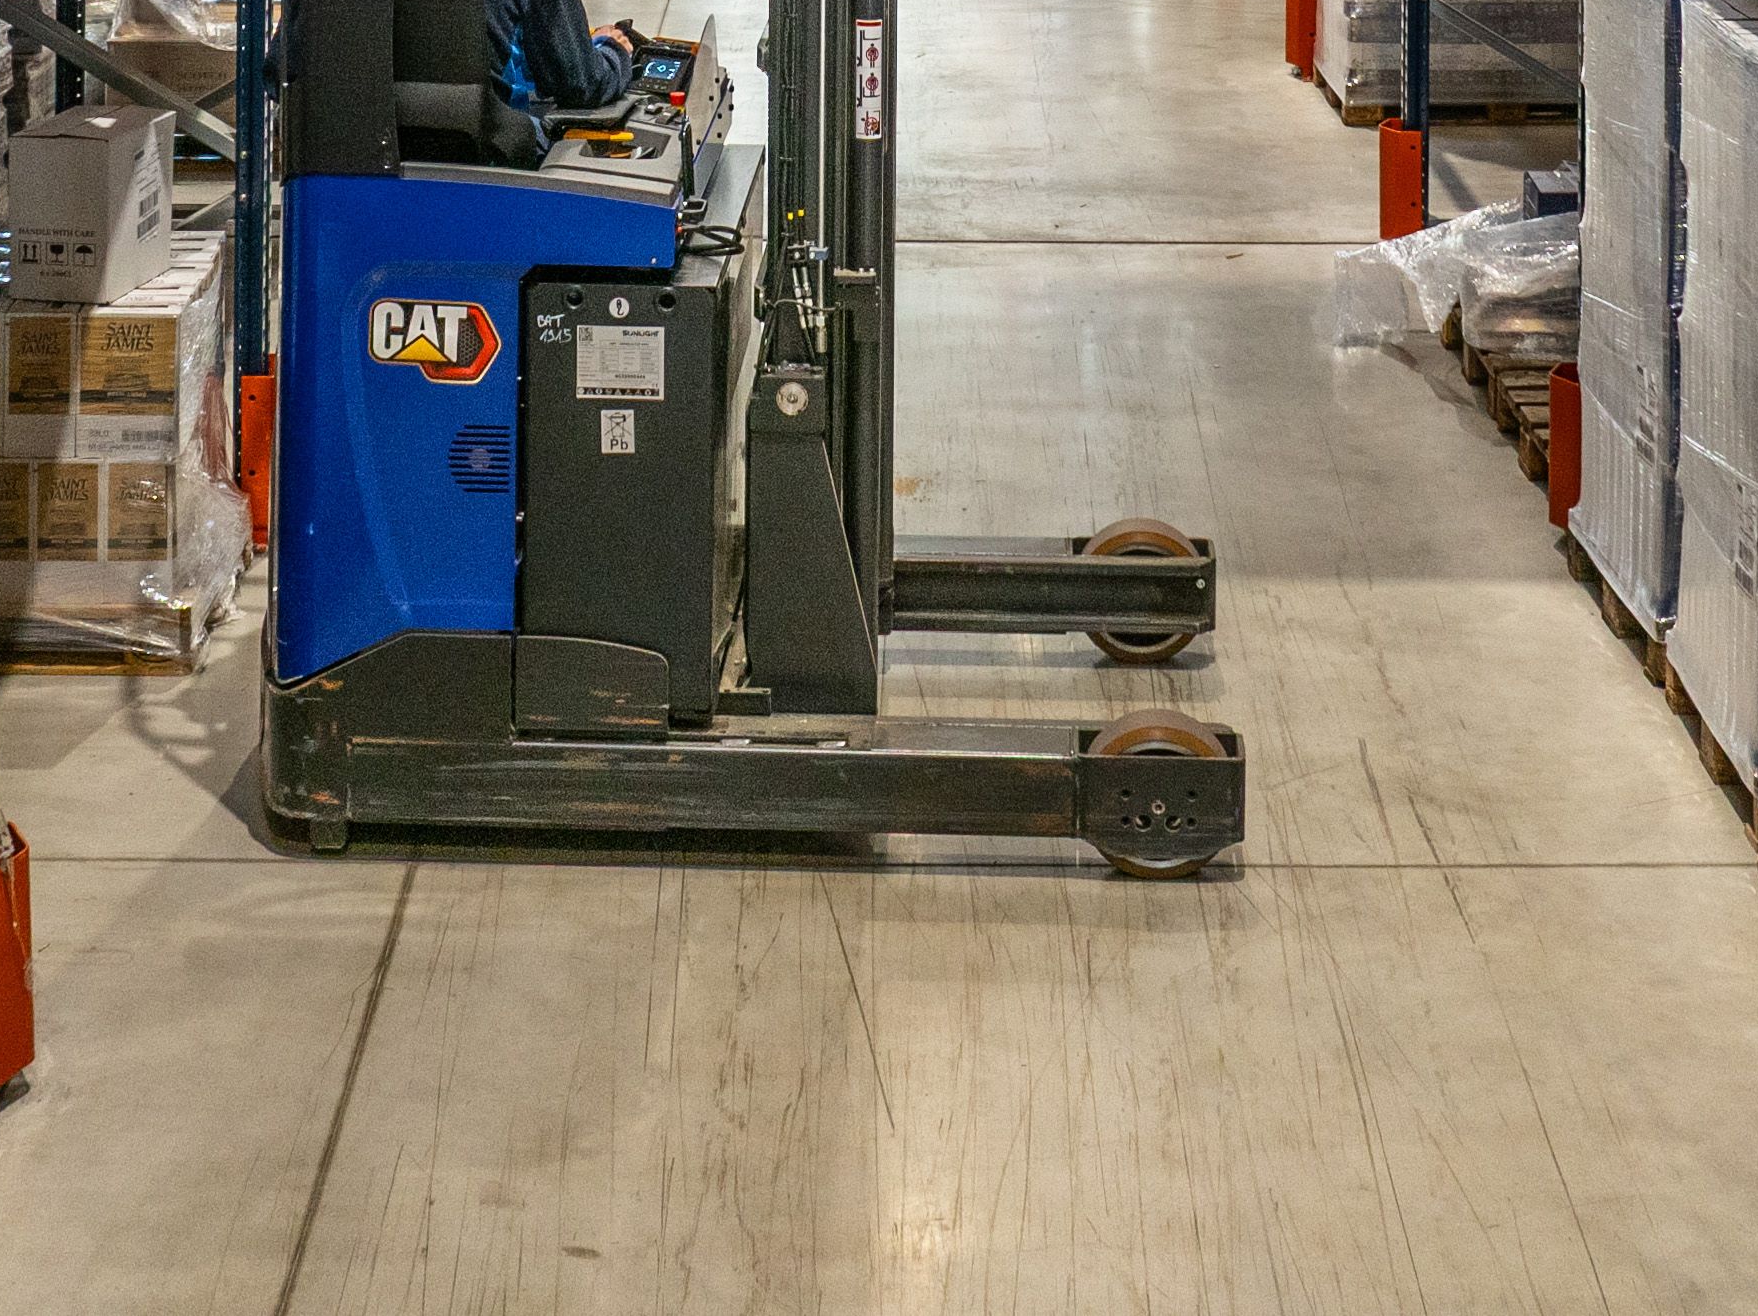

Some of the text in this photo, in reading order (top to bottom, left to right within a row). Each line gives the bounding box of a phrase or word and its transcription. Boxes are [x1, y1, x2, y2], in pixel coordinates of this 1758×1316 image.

[18, 228, 95, 238] HANDLE WITH CARE
[537, 314, 565, 327] BAT
[105, 322, 153, 337] SAINT
[373, 301, 468, 363] CAT
[101, 337, 154, 351] JAMES
[610, 438, 628, 450] Pb
